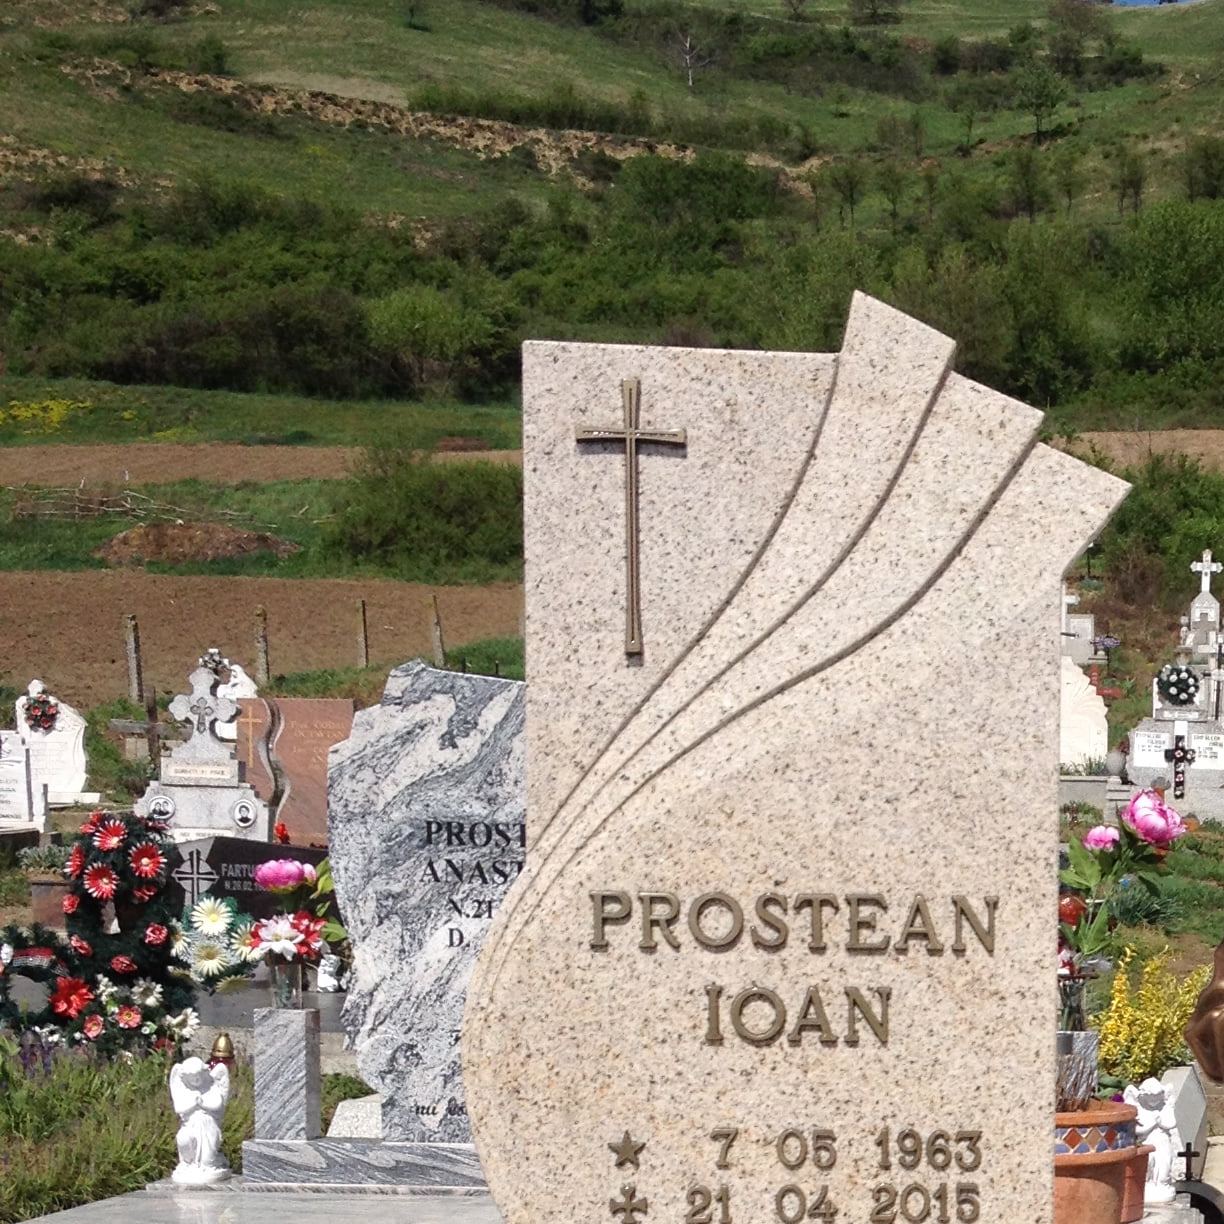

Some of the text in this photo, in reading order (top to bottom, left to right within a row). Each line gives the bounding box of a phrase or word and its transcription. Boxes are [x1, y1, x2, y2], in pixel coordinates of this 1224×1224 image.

[589, 890, 1000, 954] PROSTEAN
[704, 982, 892, 1048] IOAN
[709, 1127, 983, 1172] 7 05 1963
